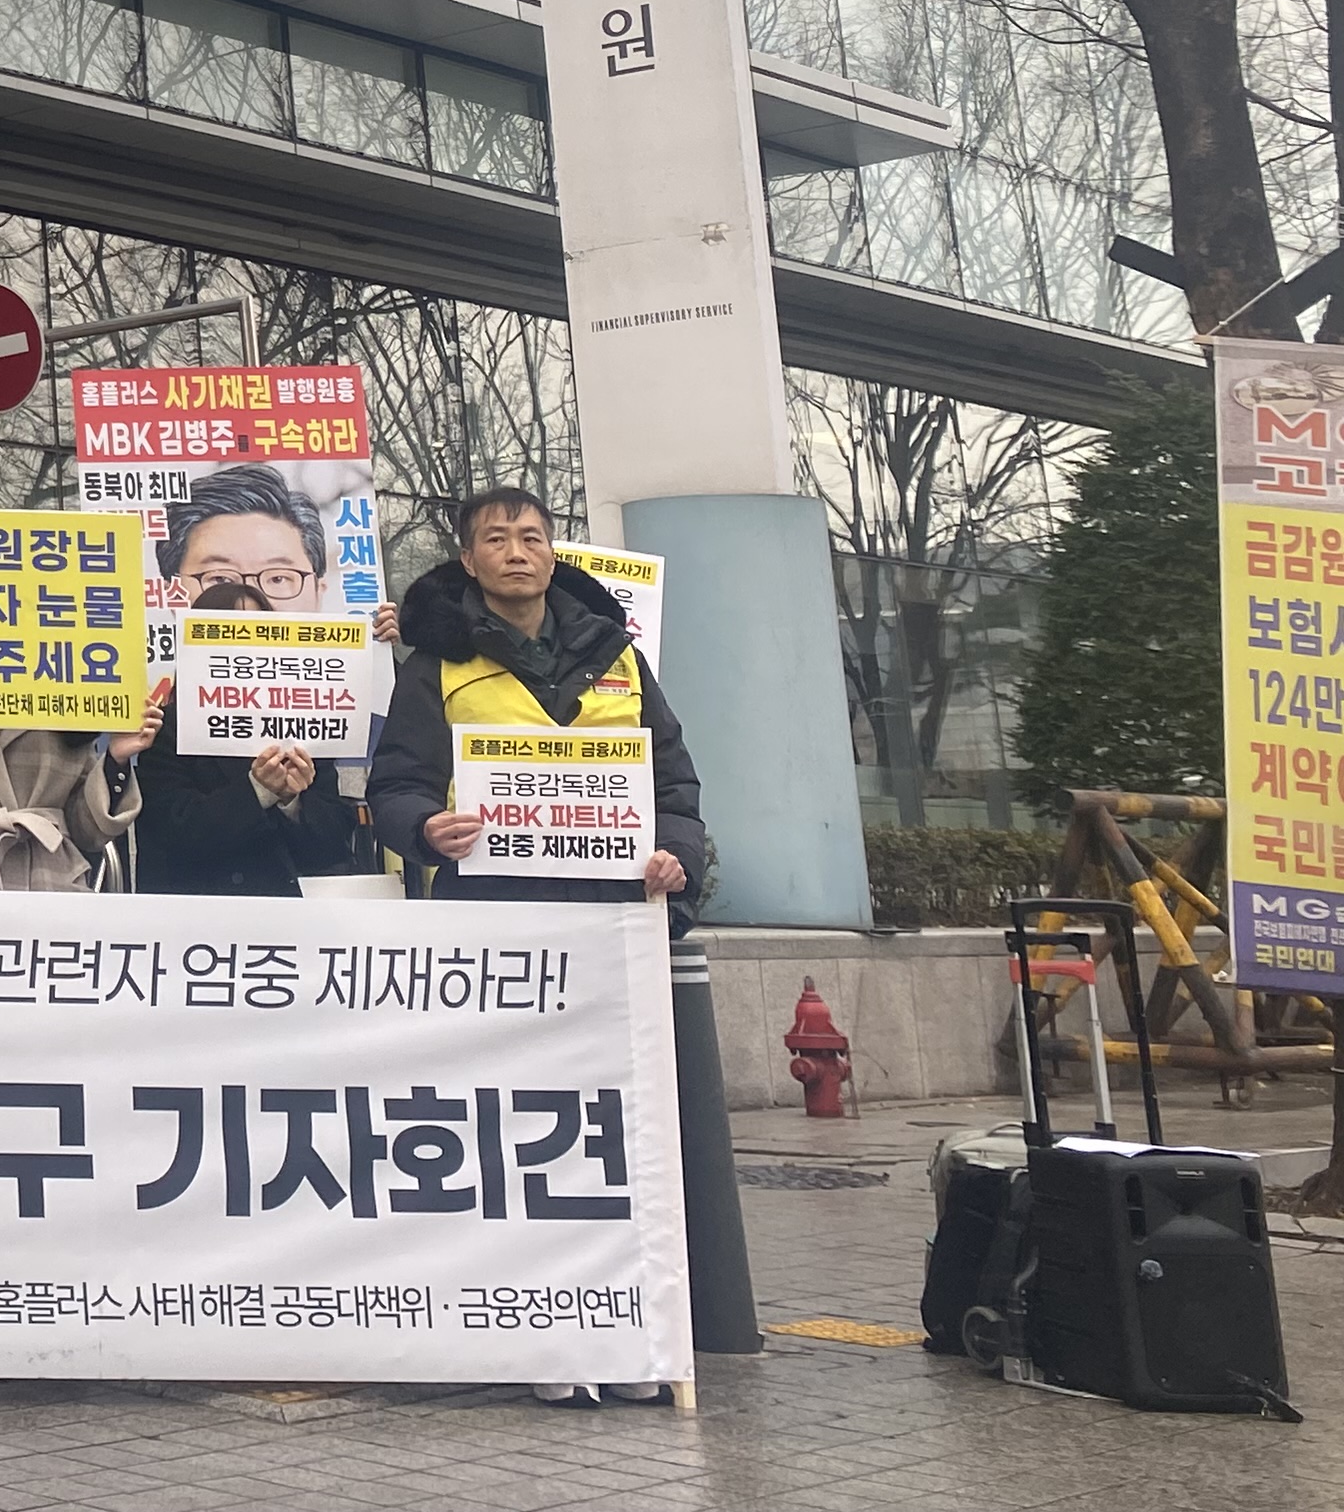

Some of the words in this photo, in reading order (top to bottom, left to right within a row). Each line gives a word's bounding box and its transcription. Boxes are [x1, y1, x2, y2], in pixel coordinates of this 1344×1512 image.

[591, 316, 633, 333] FINANCIAL
[634, 308, 692, 326] SUPERVISORY
[695, 303, 733, 318] SERVICE
[81, 381, 159, 407] 홈플러스
[165, 374, 273, 410] 사기채권
[276, 377, 356, 405] 발행원흉
[84, 422, 154, 456] MBK
[158, 420, 236, 456] 김병주
[254, 418, 358, 455] 구속하라
[83, 471, 143, 501] 동북아
[148, 471, 189, 501] 최대
[335, 497, 380, 615] 사재출
[590, 557, 652, 580] 금융사기!
[36, 585, 124, 629] 눈물
[191, 624, 251, 640] 홈플러스
[255, 625, 290, 641] 먹튀!
[297, 626, 360, 643] 금융사기!
[208, 655, 346, 681] 금융감독원은
[38, 694, 79, 717] 피해자
[84, 694, 130, 719] 비대위]
[198, 686, 262, 709] MBK
[269, 688, 356, 711] 파트너스
[207, 716, 254, 738] 엄중
[260, 718, 348, 740] 제재하라
[470, 738, 534, 756] 홈플러스
[538, 740, 573, 757] 먹튀!
[581, 740, 641, 759] 금융사기!
[489, 772, 629, 798] 금융감독원은
[1250, 742, 1344, 806] 계약
[479, 803, 544, 828] MBK
[551, 805, 642, 829] 파트너스
[487, 834, 536, 858] 엄중
[542, 835, 637, 861] 제재하라
[1255, 943, 1335, 973] 국민연대
[180, 944, 302, 1009] 엄중
[314, 947, 568, 1013] 제재하라!
[132, 1084, 632, 1221] 기자회견
[129, 1281, 195, 1327] 사태
[201, 1283, 267, 1329] 해결
[270, 1284, 434, 1332] 공동대책위
[458, 1285, 644, 1333] 금융정의연대
